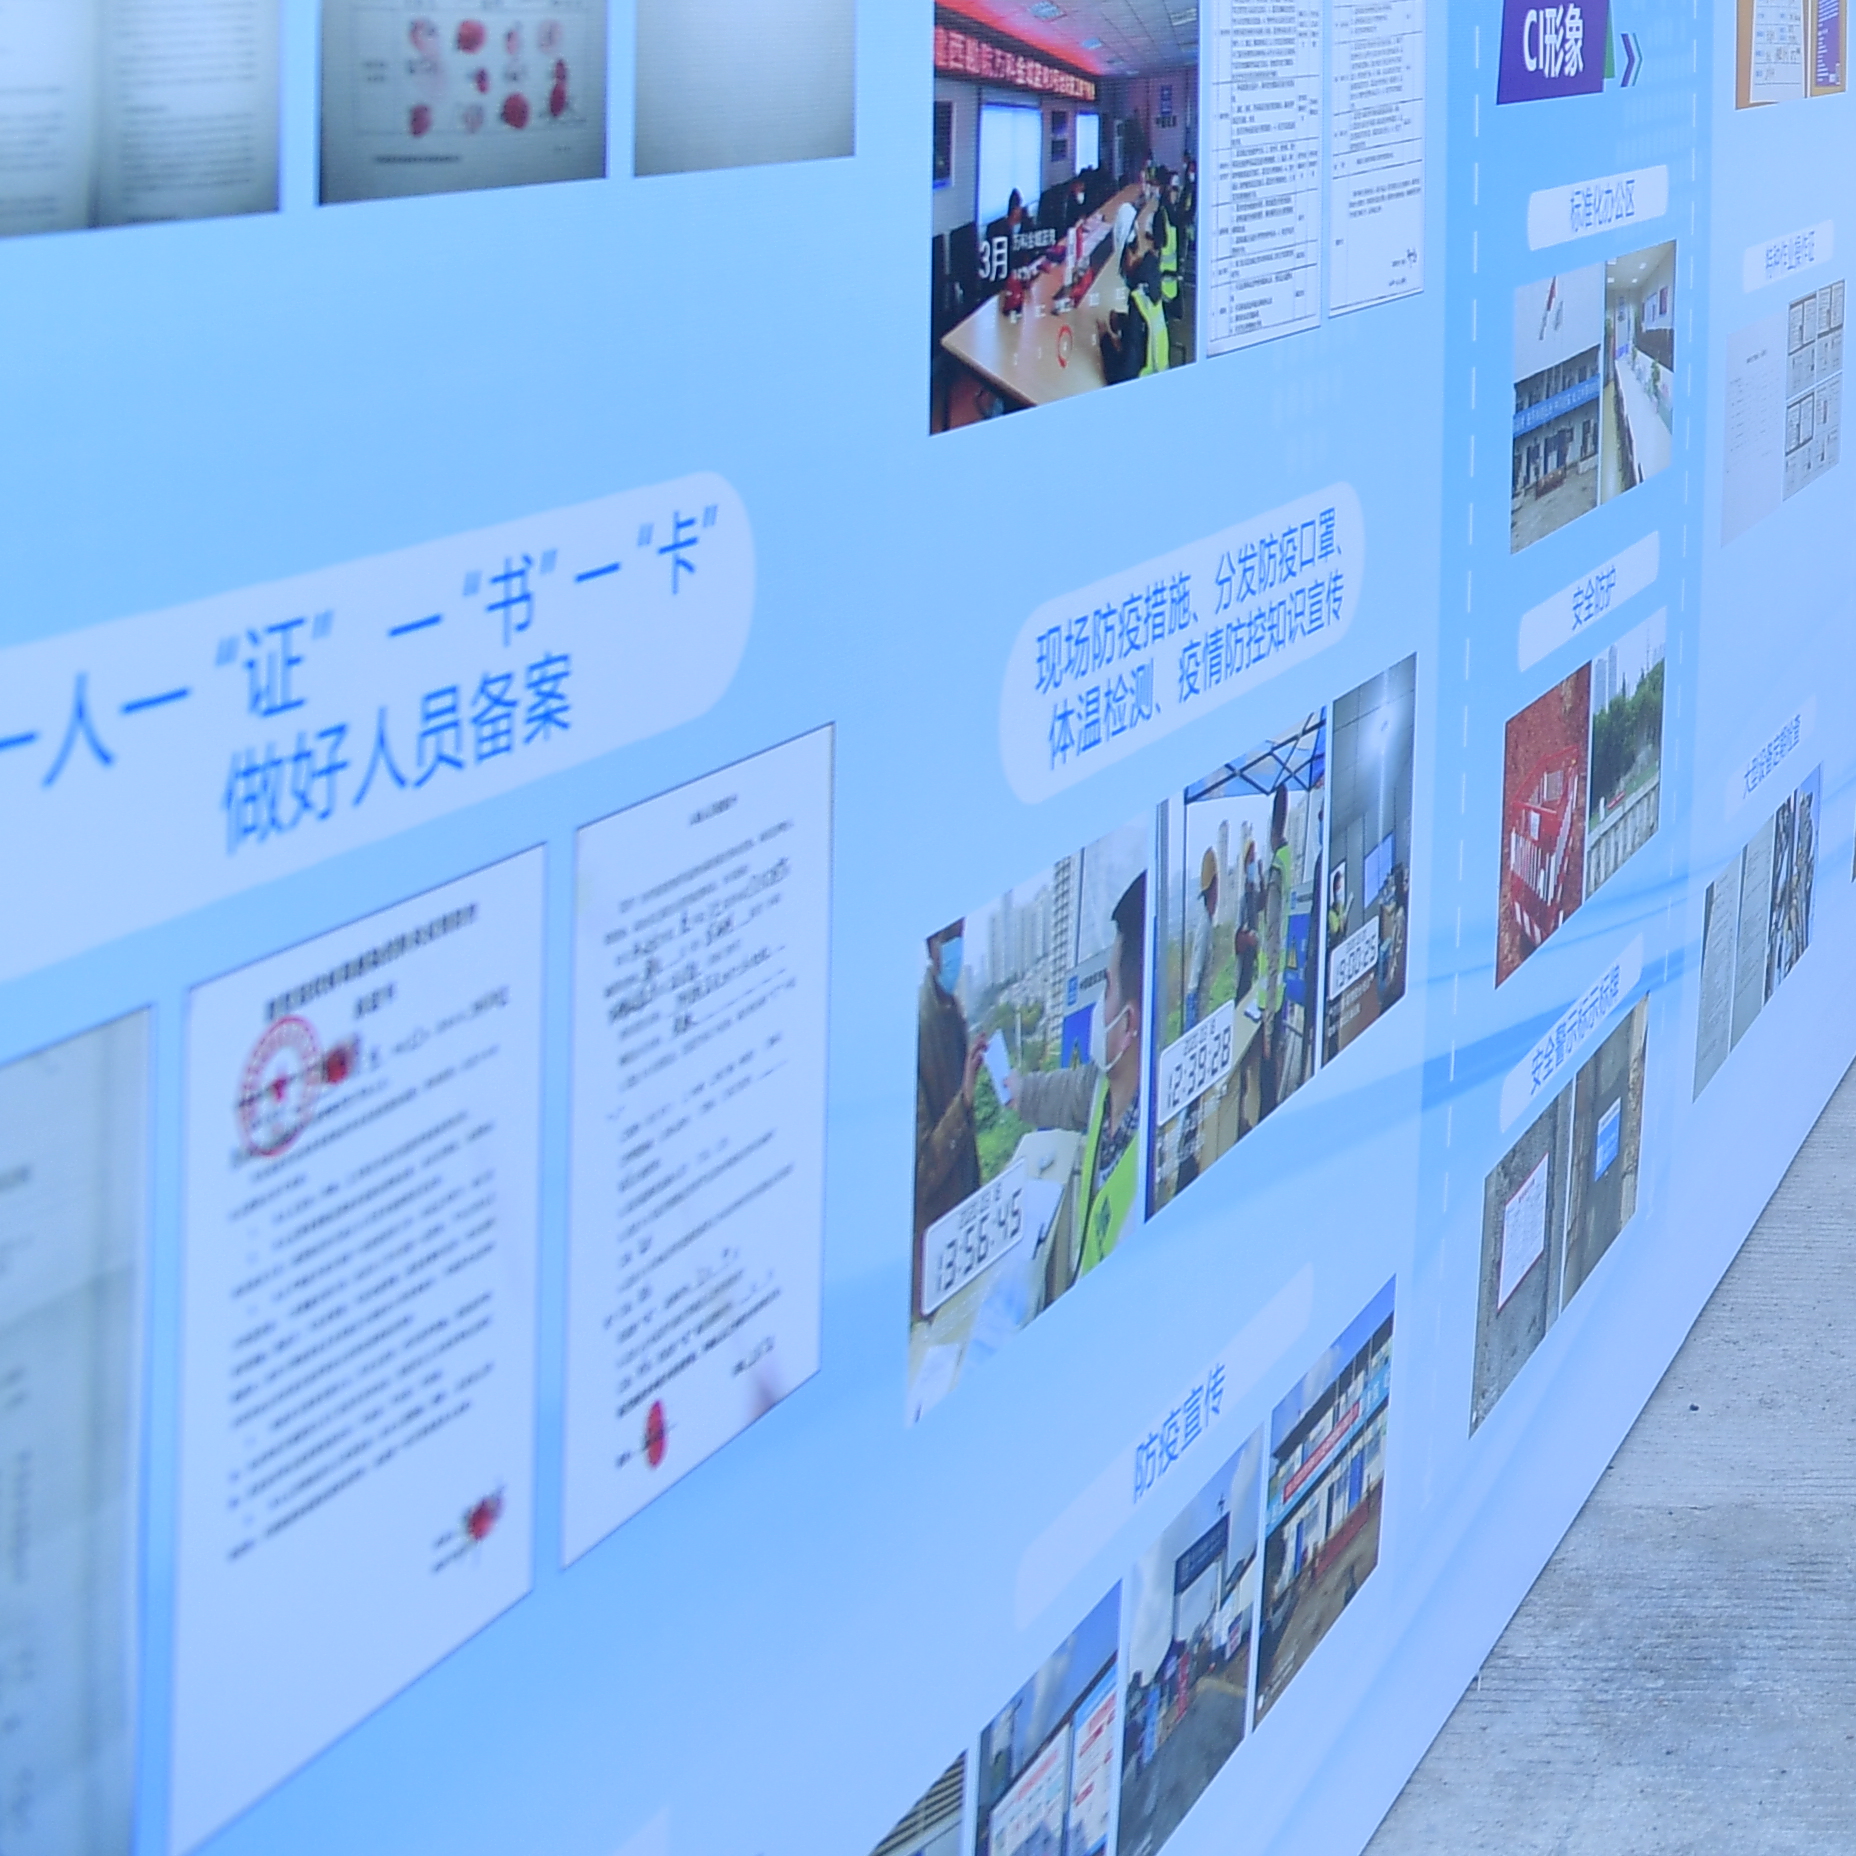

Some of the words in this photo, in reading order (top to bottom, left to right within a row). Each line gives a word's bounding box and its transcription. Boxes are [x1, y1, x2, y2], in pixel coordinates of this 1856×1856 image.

[1523, 2, 1586, 80] CI形象
[1568, 178, 1637, 234] 标准化办公区
[978, 235, 1009, 282] 3月
[1034, 505, 1345, 697] 现场防疫措施、分发防疫口罩、
[1570, 563, 1617, 631] 安全防护
[1047, 570, 1346, 771] 体温检测、疫情防控知识宣传
[220, 652, 573, 856] 做好人员备案
[1166, 1025, 1232, 1109] 12:39:28
[1133, 1361, 1227, 1505] 防疫宣传
